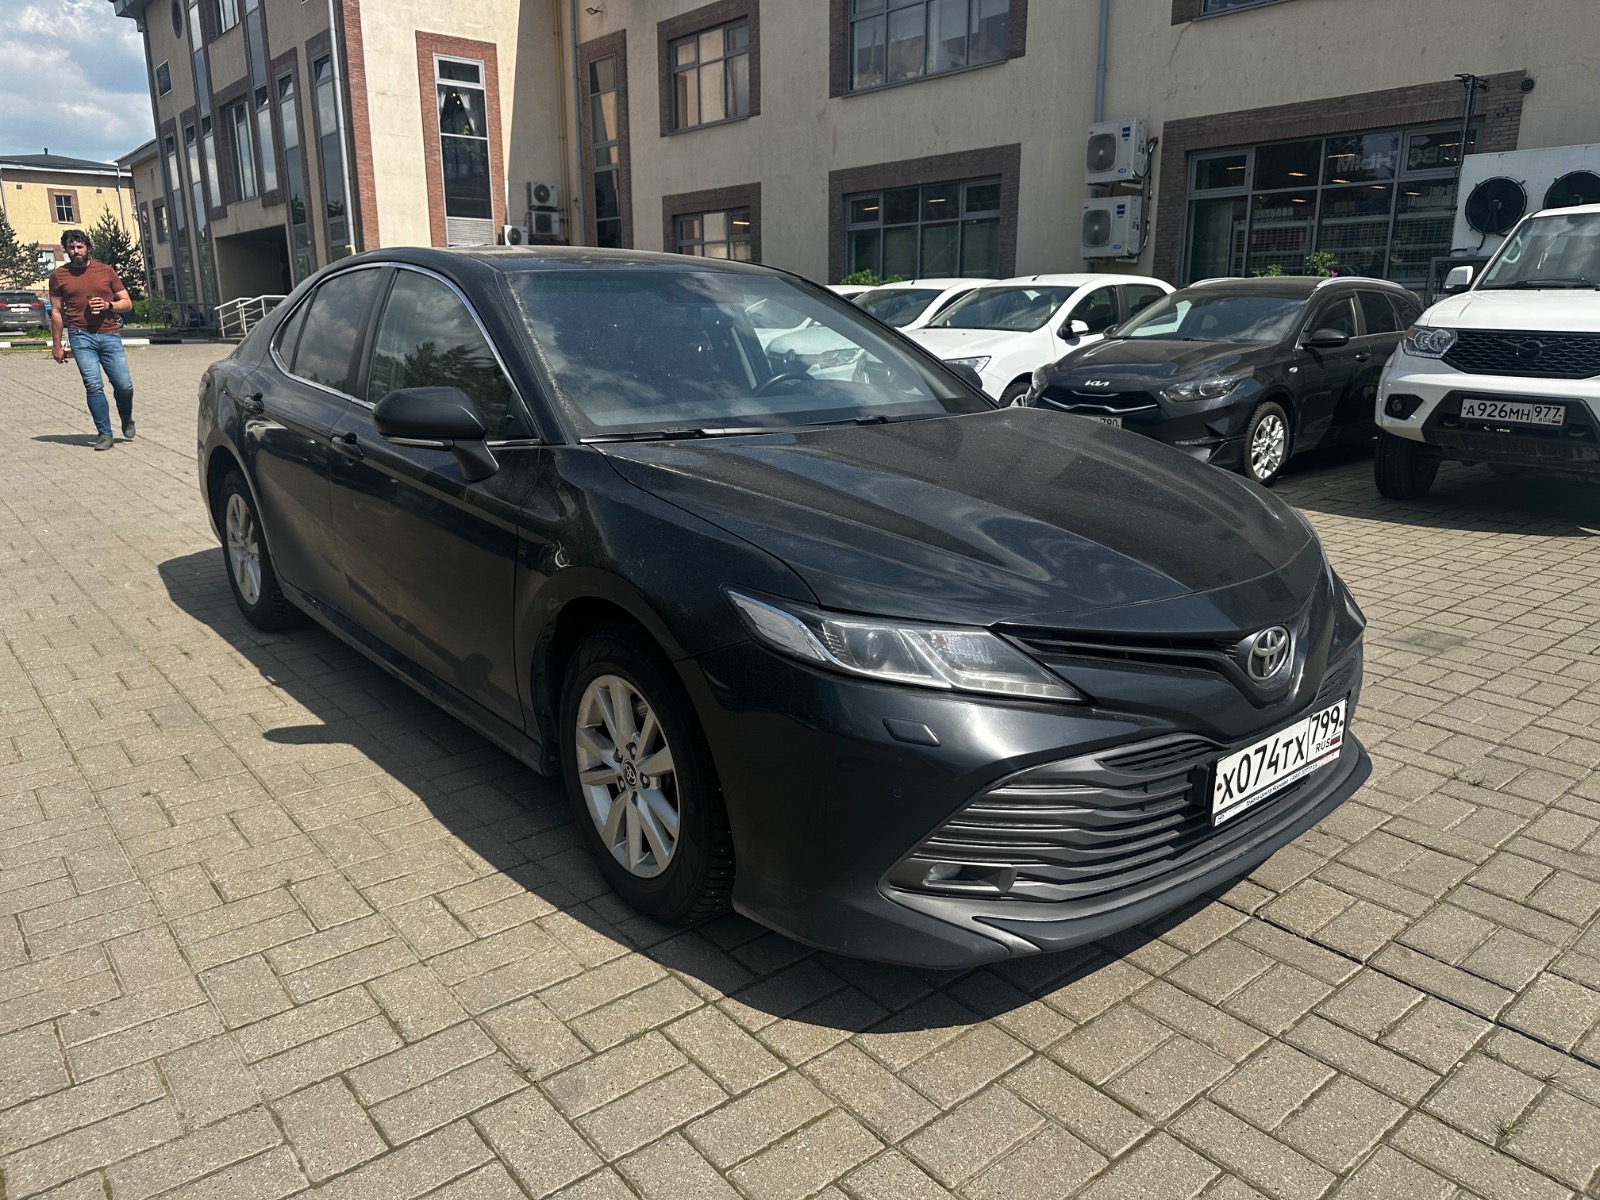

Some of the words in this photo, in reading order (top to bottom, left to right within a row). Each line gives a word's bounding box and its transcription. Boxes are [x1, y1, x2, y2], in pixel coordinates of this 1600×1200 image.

[1465, 402, 1531, 421] А926МН
[1534, 405, 1561, 419] 977
[1315, 737, 1331, 753] RUS
[1219, 731, 1307, 805] Х074ТХ
[1311, 705, 1341, 745] 799
